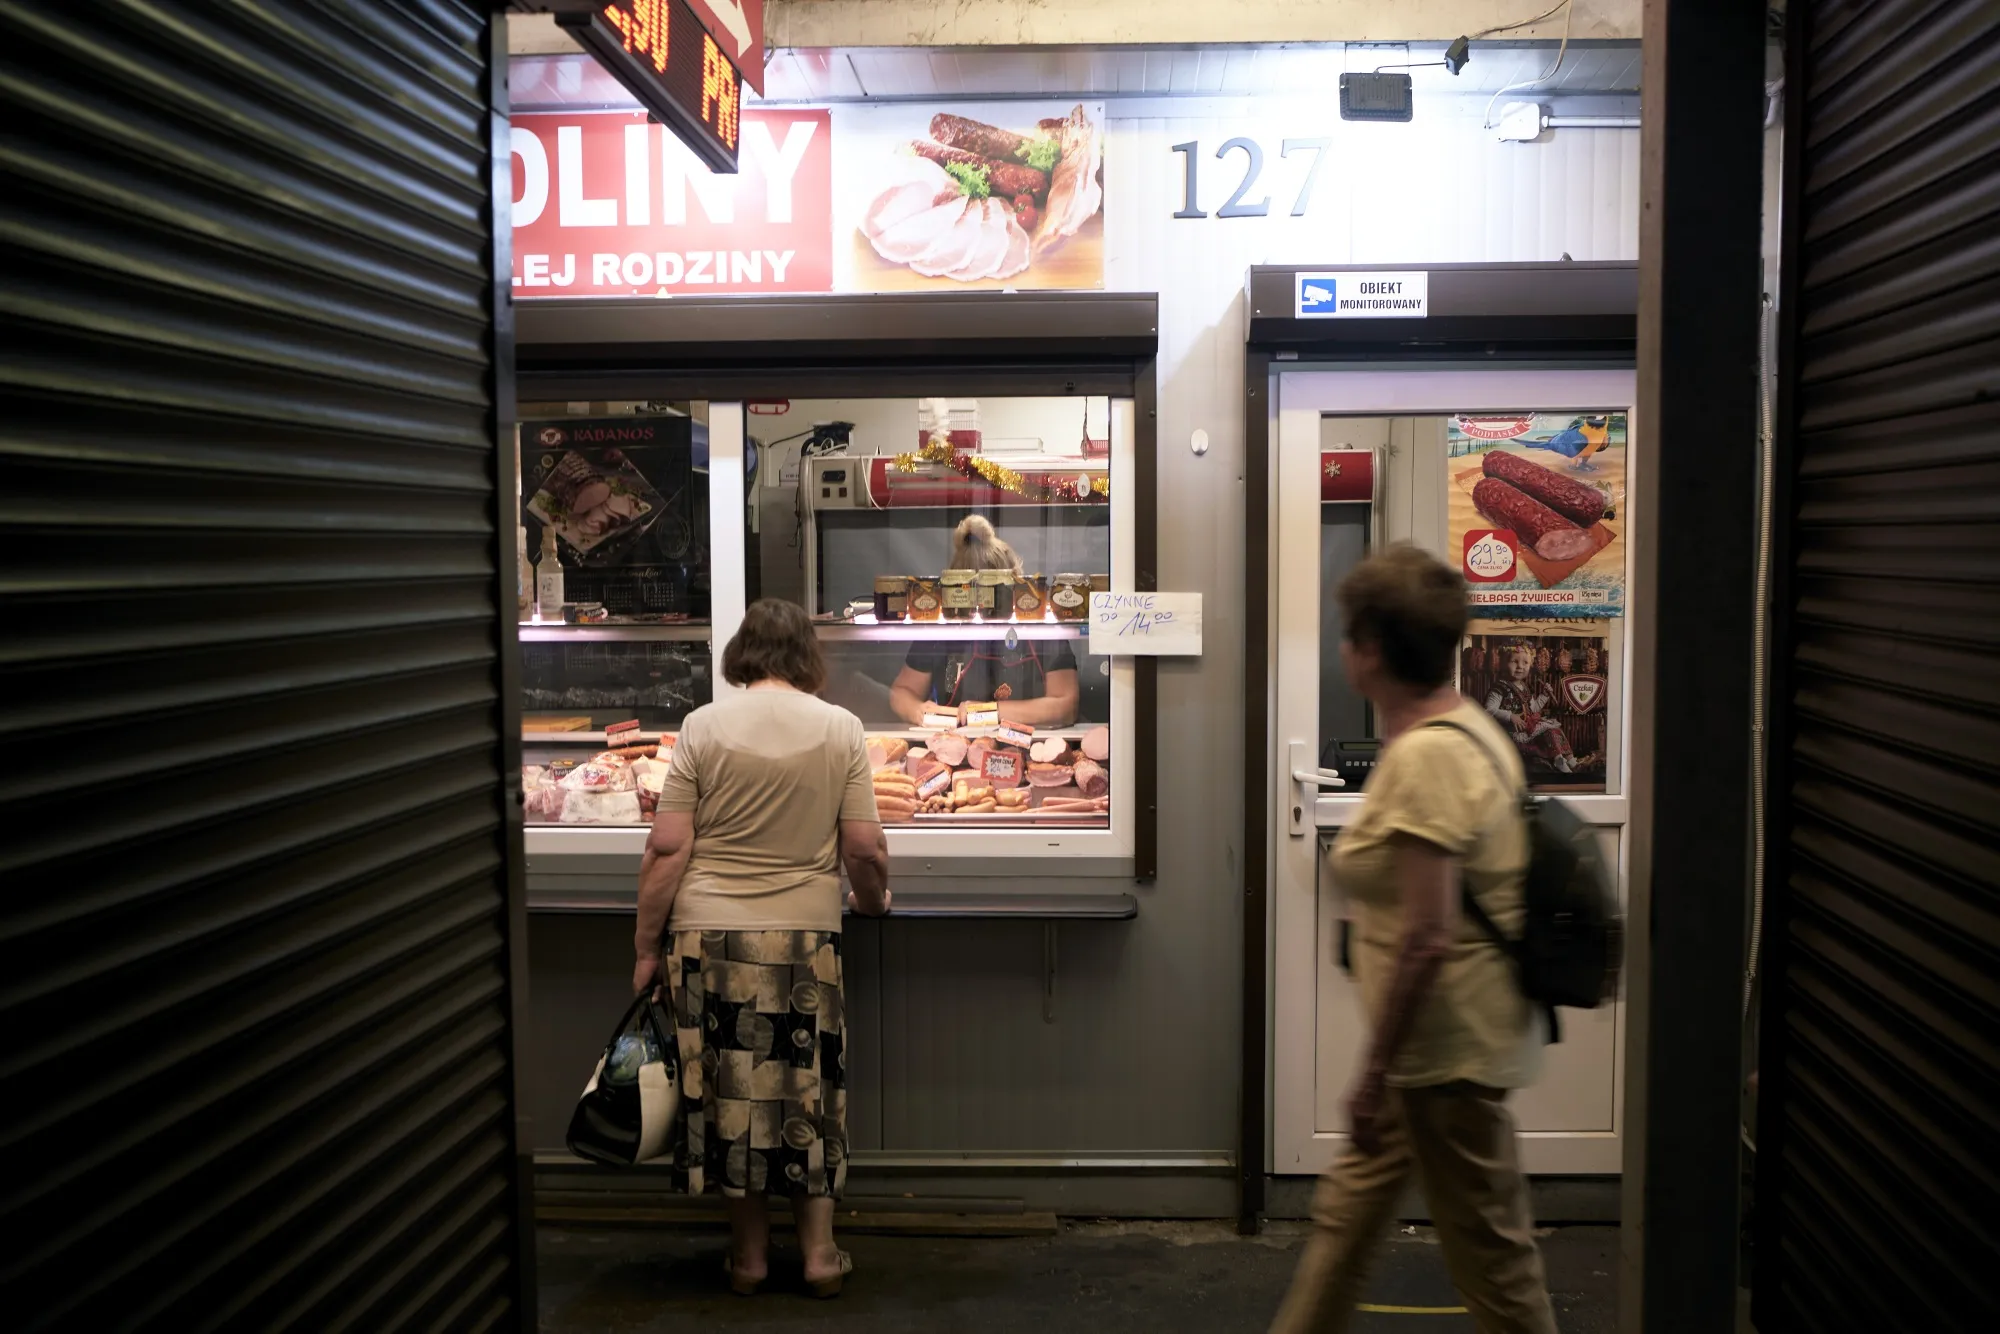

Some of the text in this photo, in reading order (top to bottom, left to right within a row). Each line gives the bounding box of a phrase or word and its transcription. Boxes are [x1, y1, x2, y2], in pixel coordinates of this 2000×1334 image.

[1172, 136, 1332, 219] 127
[592, 250, 795, 286] RODZINY
[1360, 282, 1403, 294] OBIEKT
[1340, 299, 1421, 309] MONITOROWANY
[1093, 593, 1157, 610] CZYNNE
[1468, 592, 1574, 603] KIEŁBASA ŻYWIECKA
